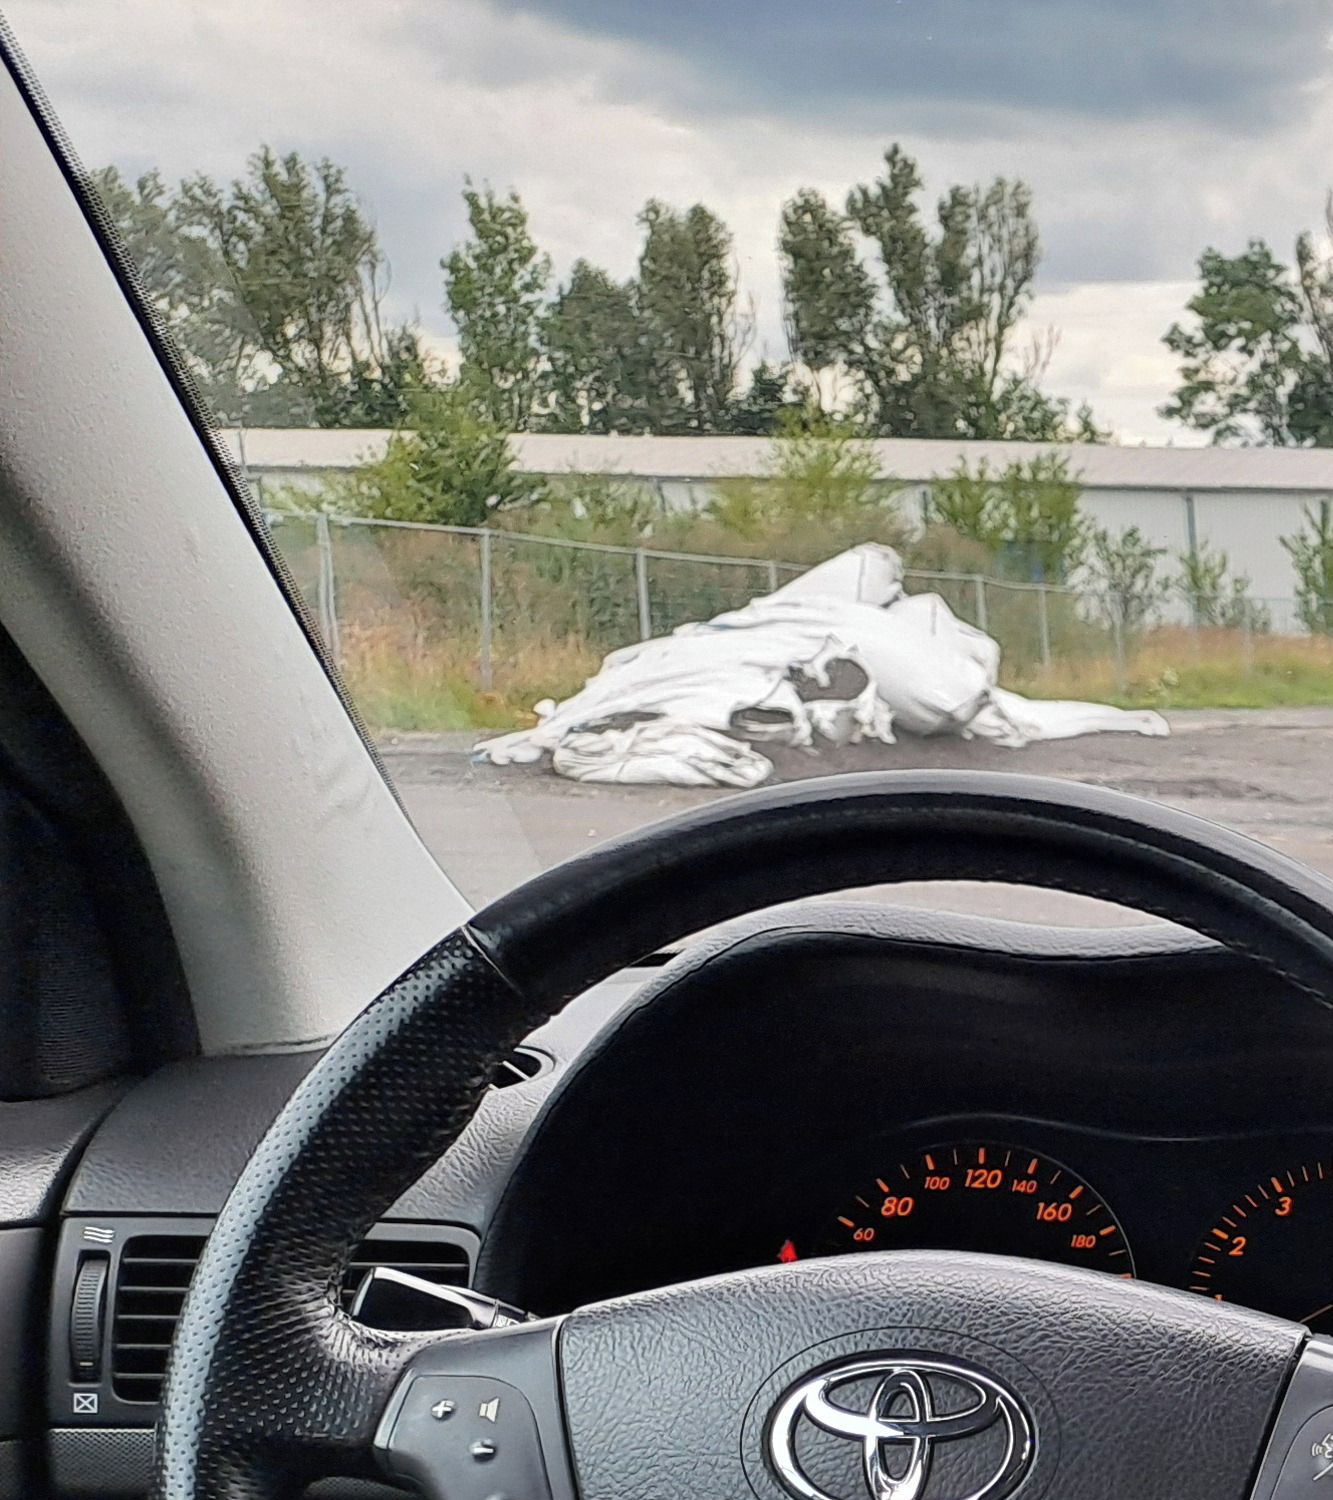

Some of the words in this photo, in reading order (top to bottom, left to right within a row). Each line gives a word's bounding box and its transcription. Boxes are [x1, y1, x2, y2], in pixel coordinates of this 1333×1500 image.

[924, 1176, 950, 1190] 100
[964, 1169, 1002, 1189] 120
[1012, 1179, 1037, 1193] 140
[880, 1196, 914, 1216] 80
[1036, 1202, 1072, 1222] 160
[1275, 1197, 1293, 1216] 3
[853, 1227, 875, 1242] 60
[1071, 1234, 1096, 1248] 180
[1228, 1236, 1246, 1256] 2
